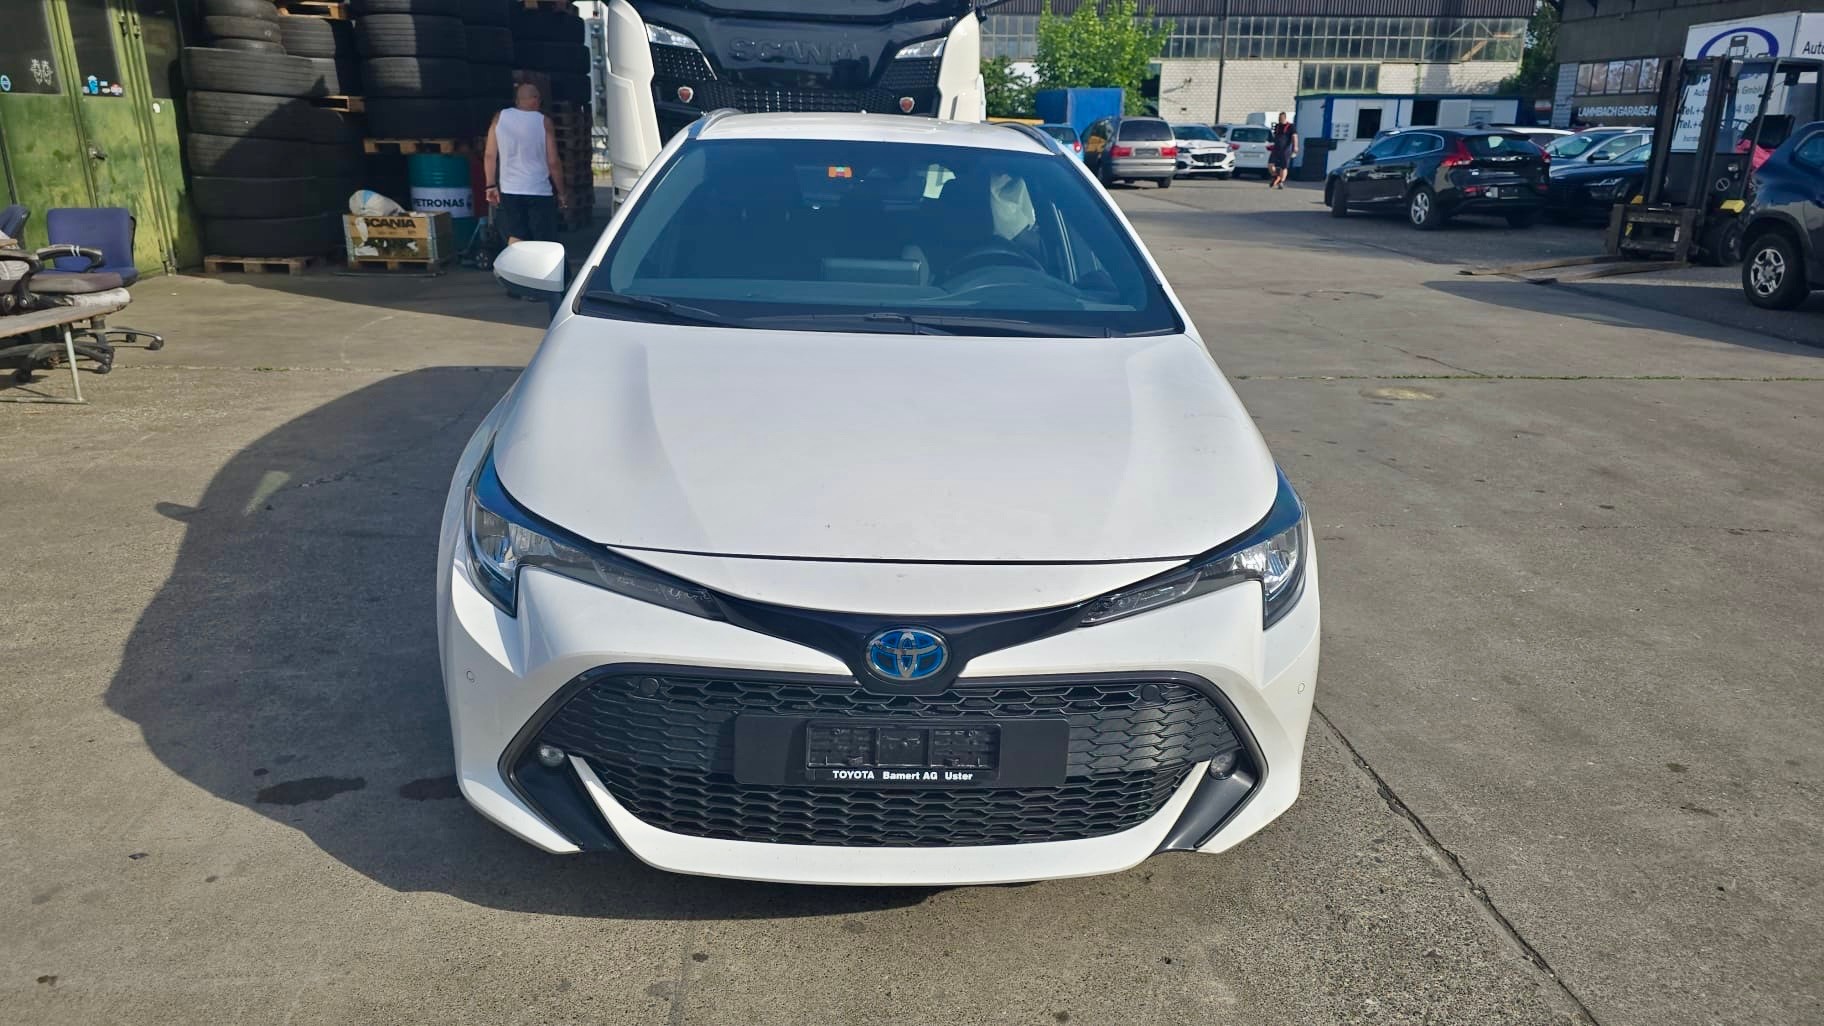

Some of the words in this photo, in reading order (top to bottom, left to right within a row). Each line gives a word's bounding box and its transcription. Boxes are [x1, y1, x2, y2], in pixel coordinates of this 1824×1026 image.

[729, 38, 861, 65] SCANIA
[1617, 105, 1649, 116] GARAGE
[832, 770, 875, 780] TOYOTA
[882, 771, 921, 780] Bamert
[922, 771, 938, 781] AG
[944, 771, 973, 781] Uster
